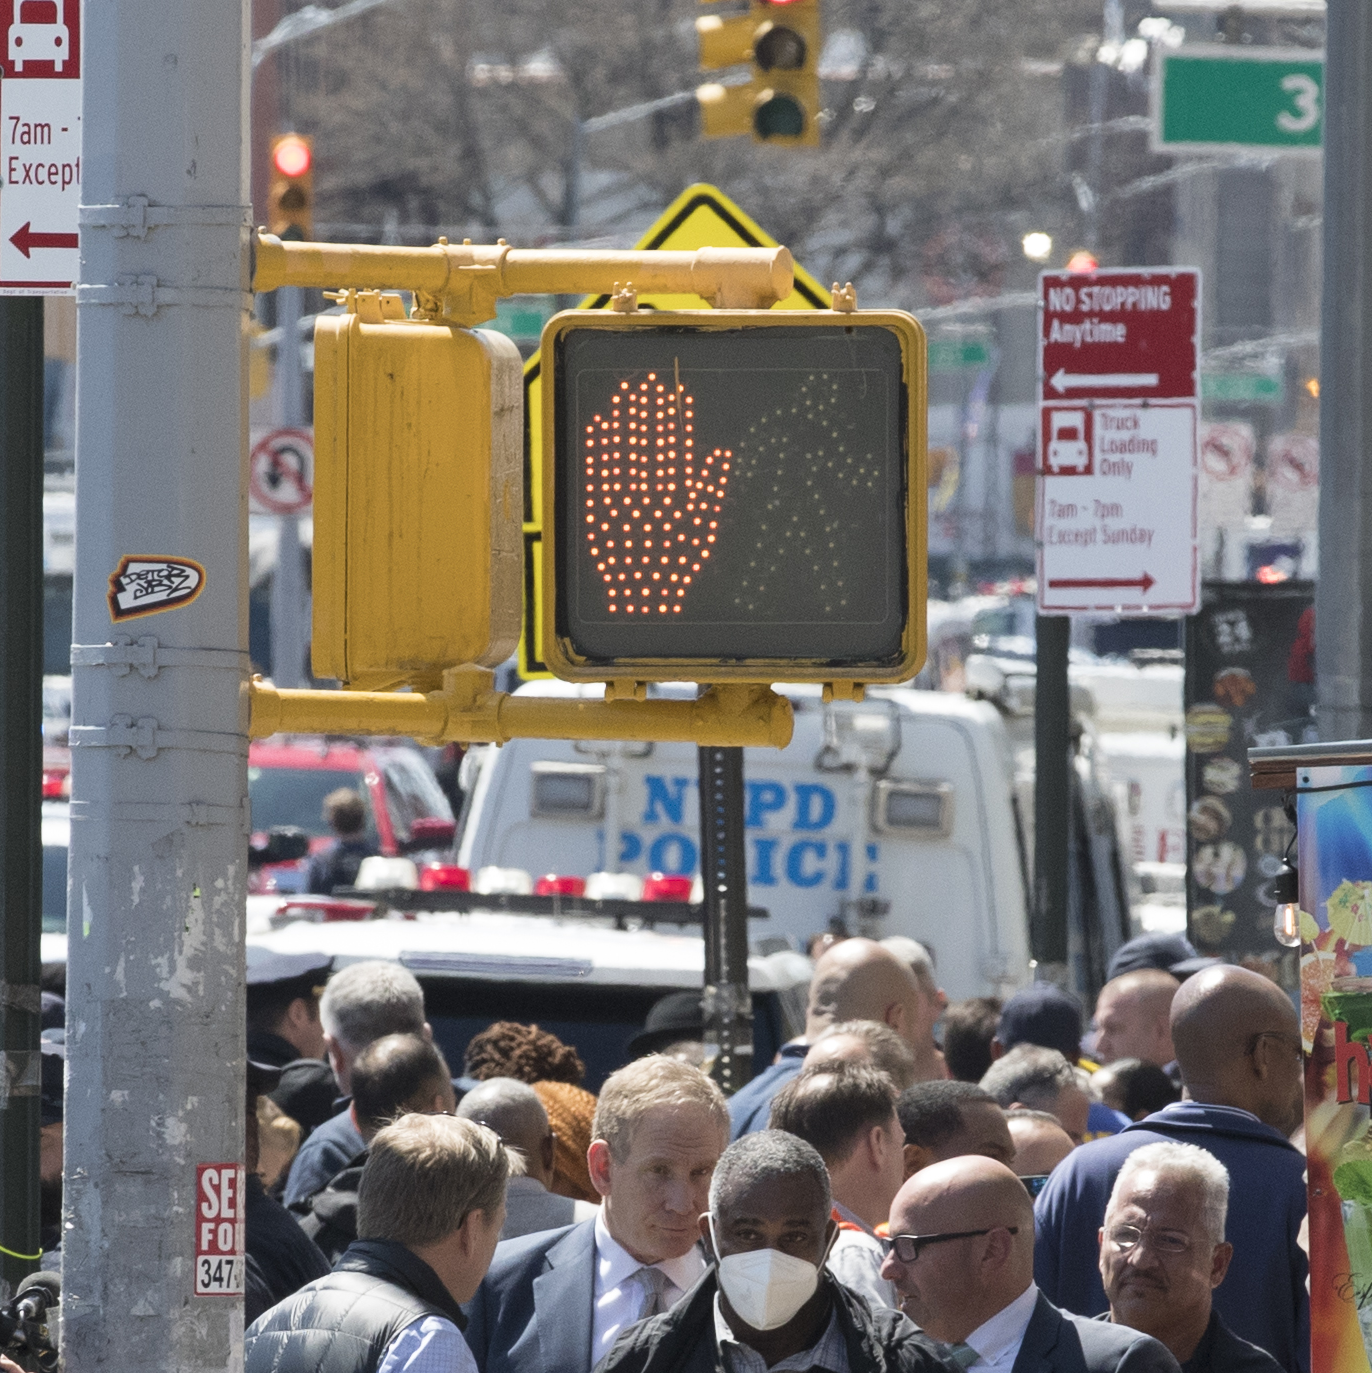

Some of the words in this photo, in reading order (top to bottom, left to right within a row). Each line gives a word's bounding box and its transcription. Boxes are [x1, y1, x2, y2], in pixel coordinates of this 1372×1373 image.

[1276, 73, 1320, 133] 3
[8, 115, 52, 146] 7am
[1048, 286, 1076, 312] NO
[1079, 285, 1172, 312] STOPPING
[1049, 317, 1127, 348] Anytime
[1100, 412, 1140, 431] Truck
[1100, 436, 1158, 457] Loading
[1099, 457, 1134, 480] Only
[1101, 525, 1155, 548] Sunday
[642, 773, 837, 832] NPD
[595, 828, 880, 894] POICE
[200, 1258, 240, 1289] 347
